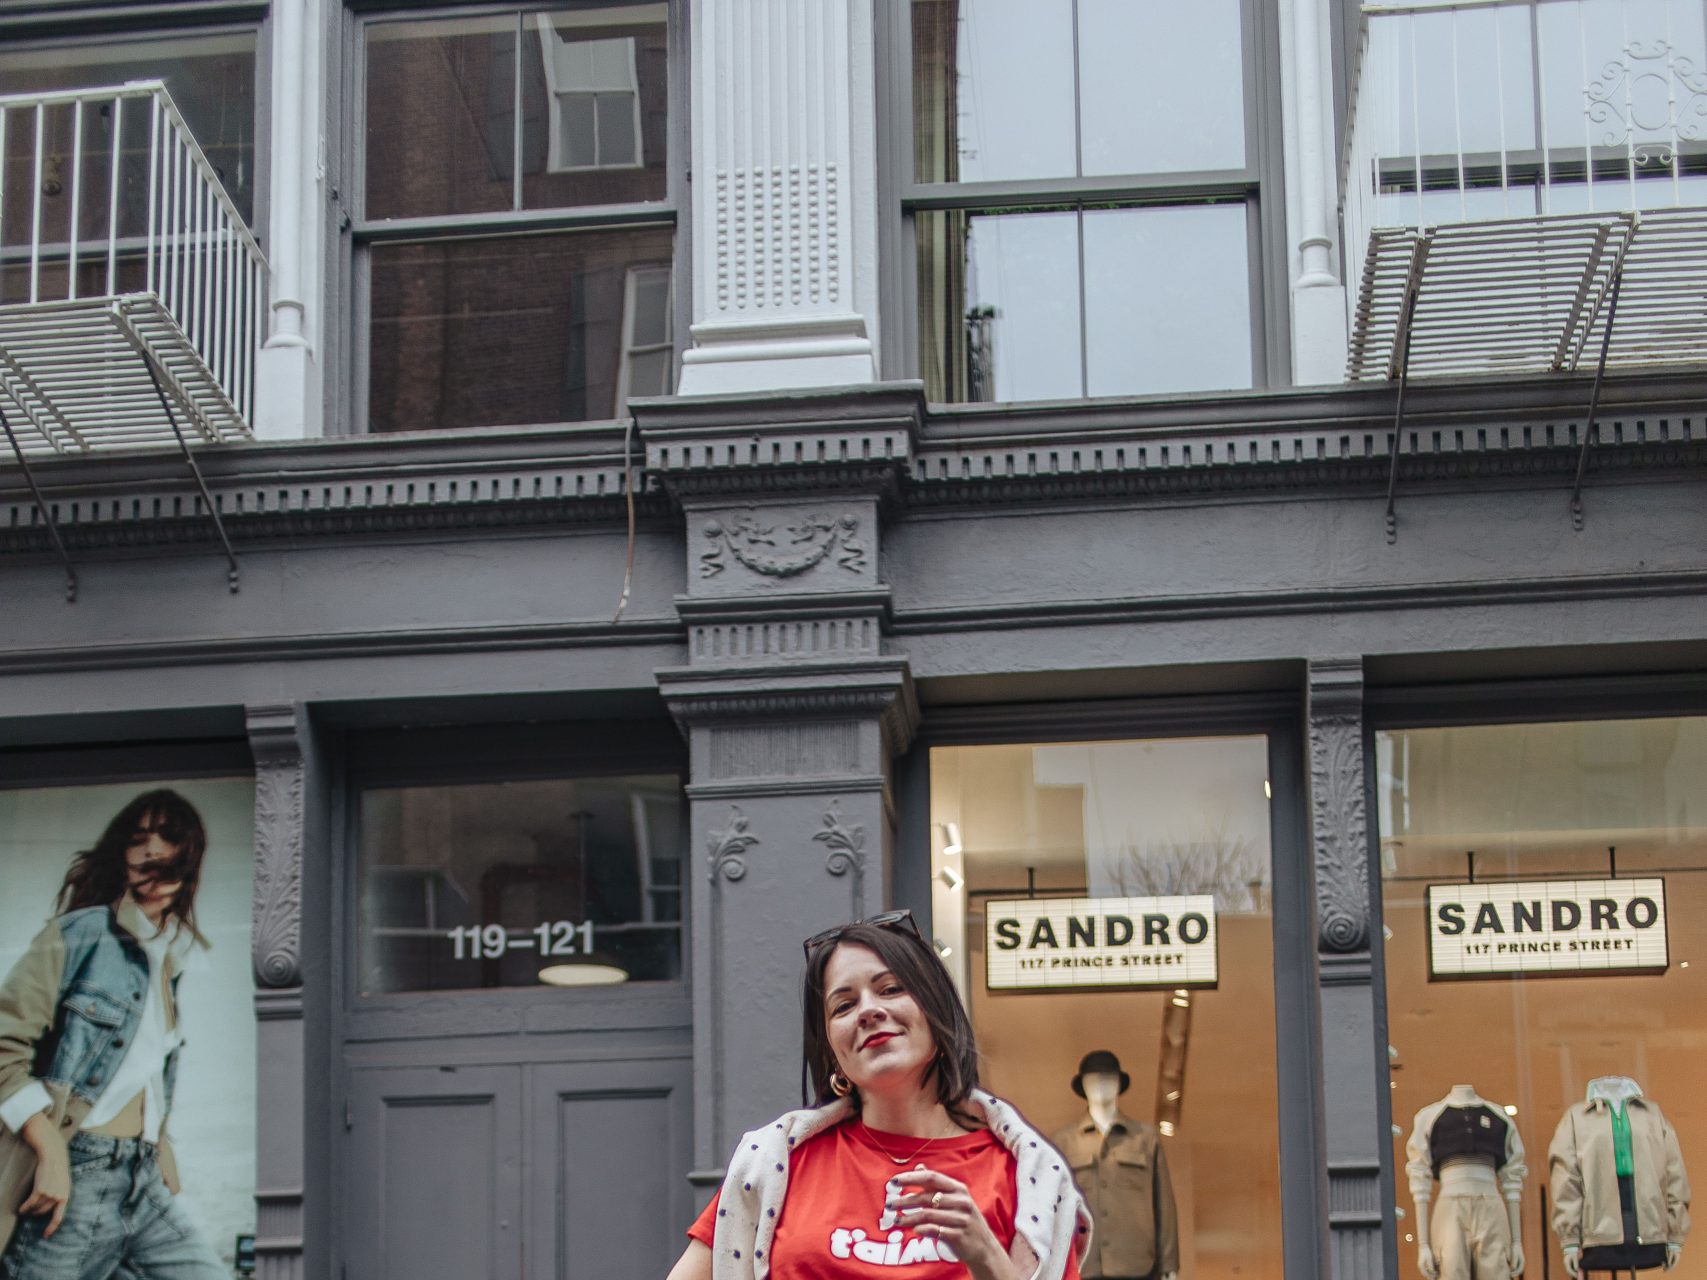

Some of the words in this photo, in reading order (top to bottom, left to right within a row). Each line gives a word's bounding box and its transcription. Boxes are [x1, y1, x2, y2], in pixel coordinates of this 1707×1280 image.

[1437, 897, 1658, 935] SANDRO
[995, 912, 1209, 950] SANDRO
[1498, 941, 1562, 953] PRINCE
[1569, 939, 1634, 951] STREET
[1051, 955, 1113, 968] PRINCE
[1120, 953, 1184, 965] STREET
